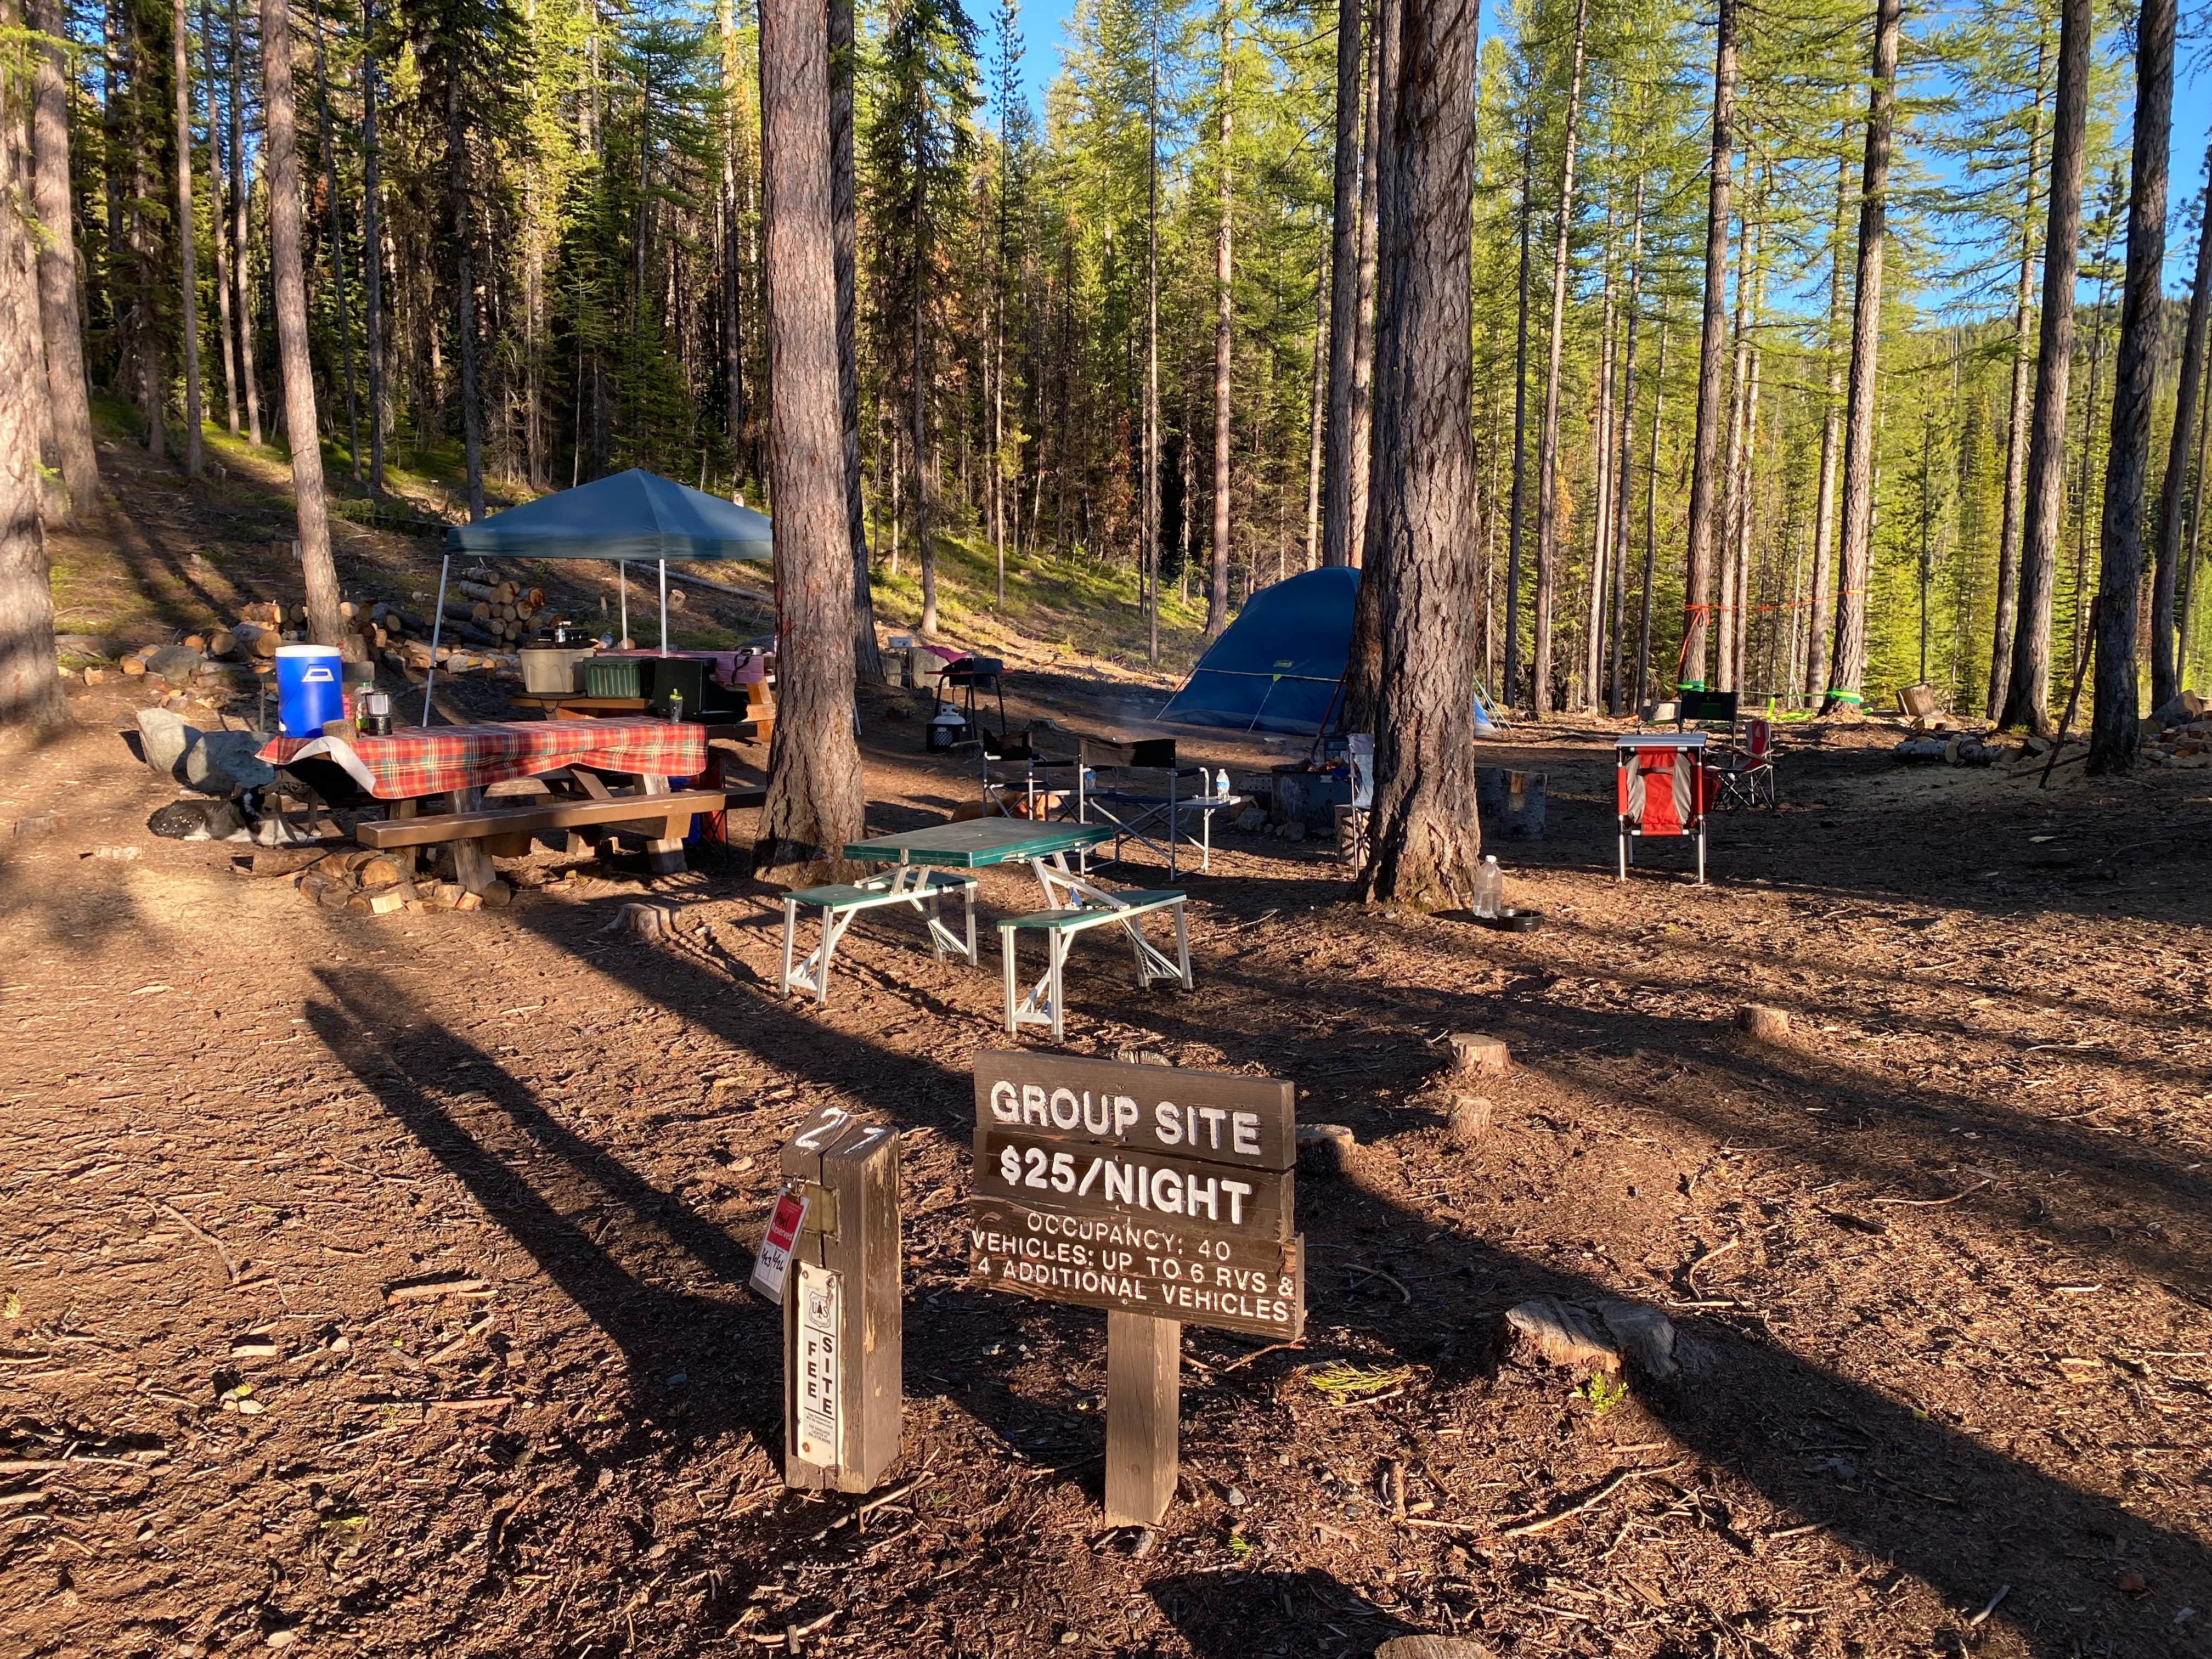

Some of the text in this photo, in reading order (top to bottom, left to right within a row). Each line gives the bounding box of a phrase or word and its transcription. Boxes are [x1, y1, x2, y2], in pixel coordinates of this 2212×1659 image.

[795, 1107, 885, 1154] 27
[990, 1080, 1262, 1155] GROUP SITE
[1000, 1144, 1252, 1224] $25/NIGHT
[771, 1222, 794, 1241] Reserved
[972, 1229, 1294, 1297] VEHICLES: UP TO 6 RVS &
[1027, 1212, 1231, 1261] OCCUPANCY: 40
[978, 1256, 1289, 1322] 4 ADDITIONAL VEHICLES
[808, 1340, 817, 1399] FEE
[822, 1336, 833, 1415] SITE
